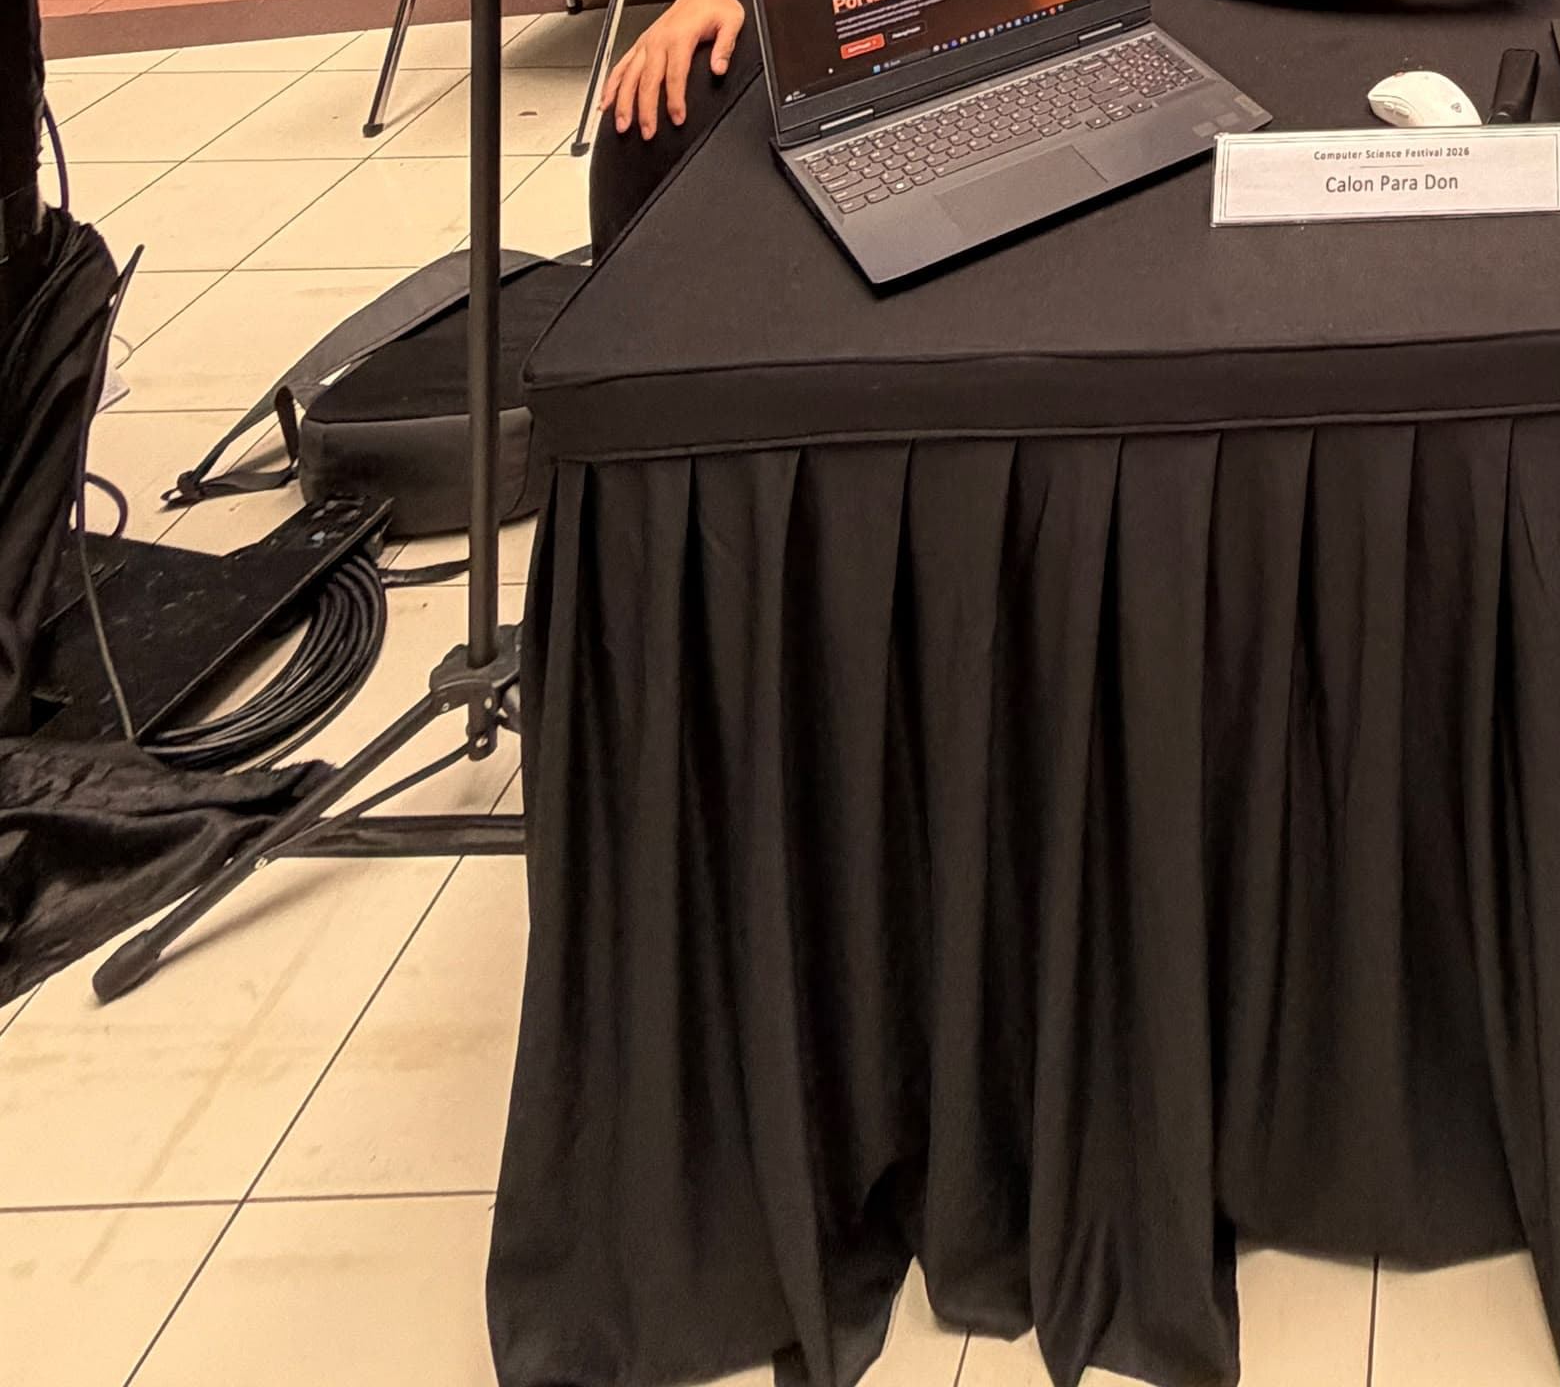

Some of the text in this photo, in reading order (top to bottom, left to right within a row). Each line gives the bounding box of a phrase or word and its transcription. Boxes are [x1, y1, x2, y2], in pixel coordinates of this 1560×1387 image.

[1314, 146, 1470, 162] Computer Science Festival 2026
[1326, 173, 1458, 193] Calon Para Don
